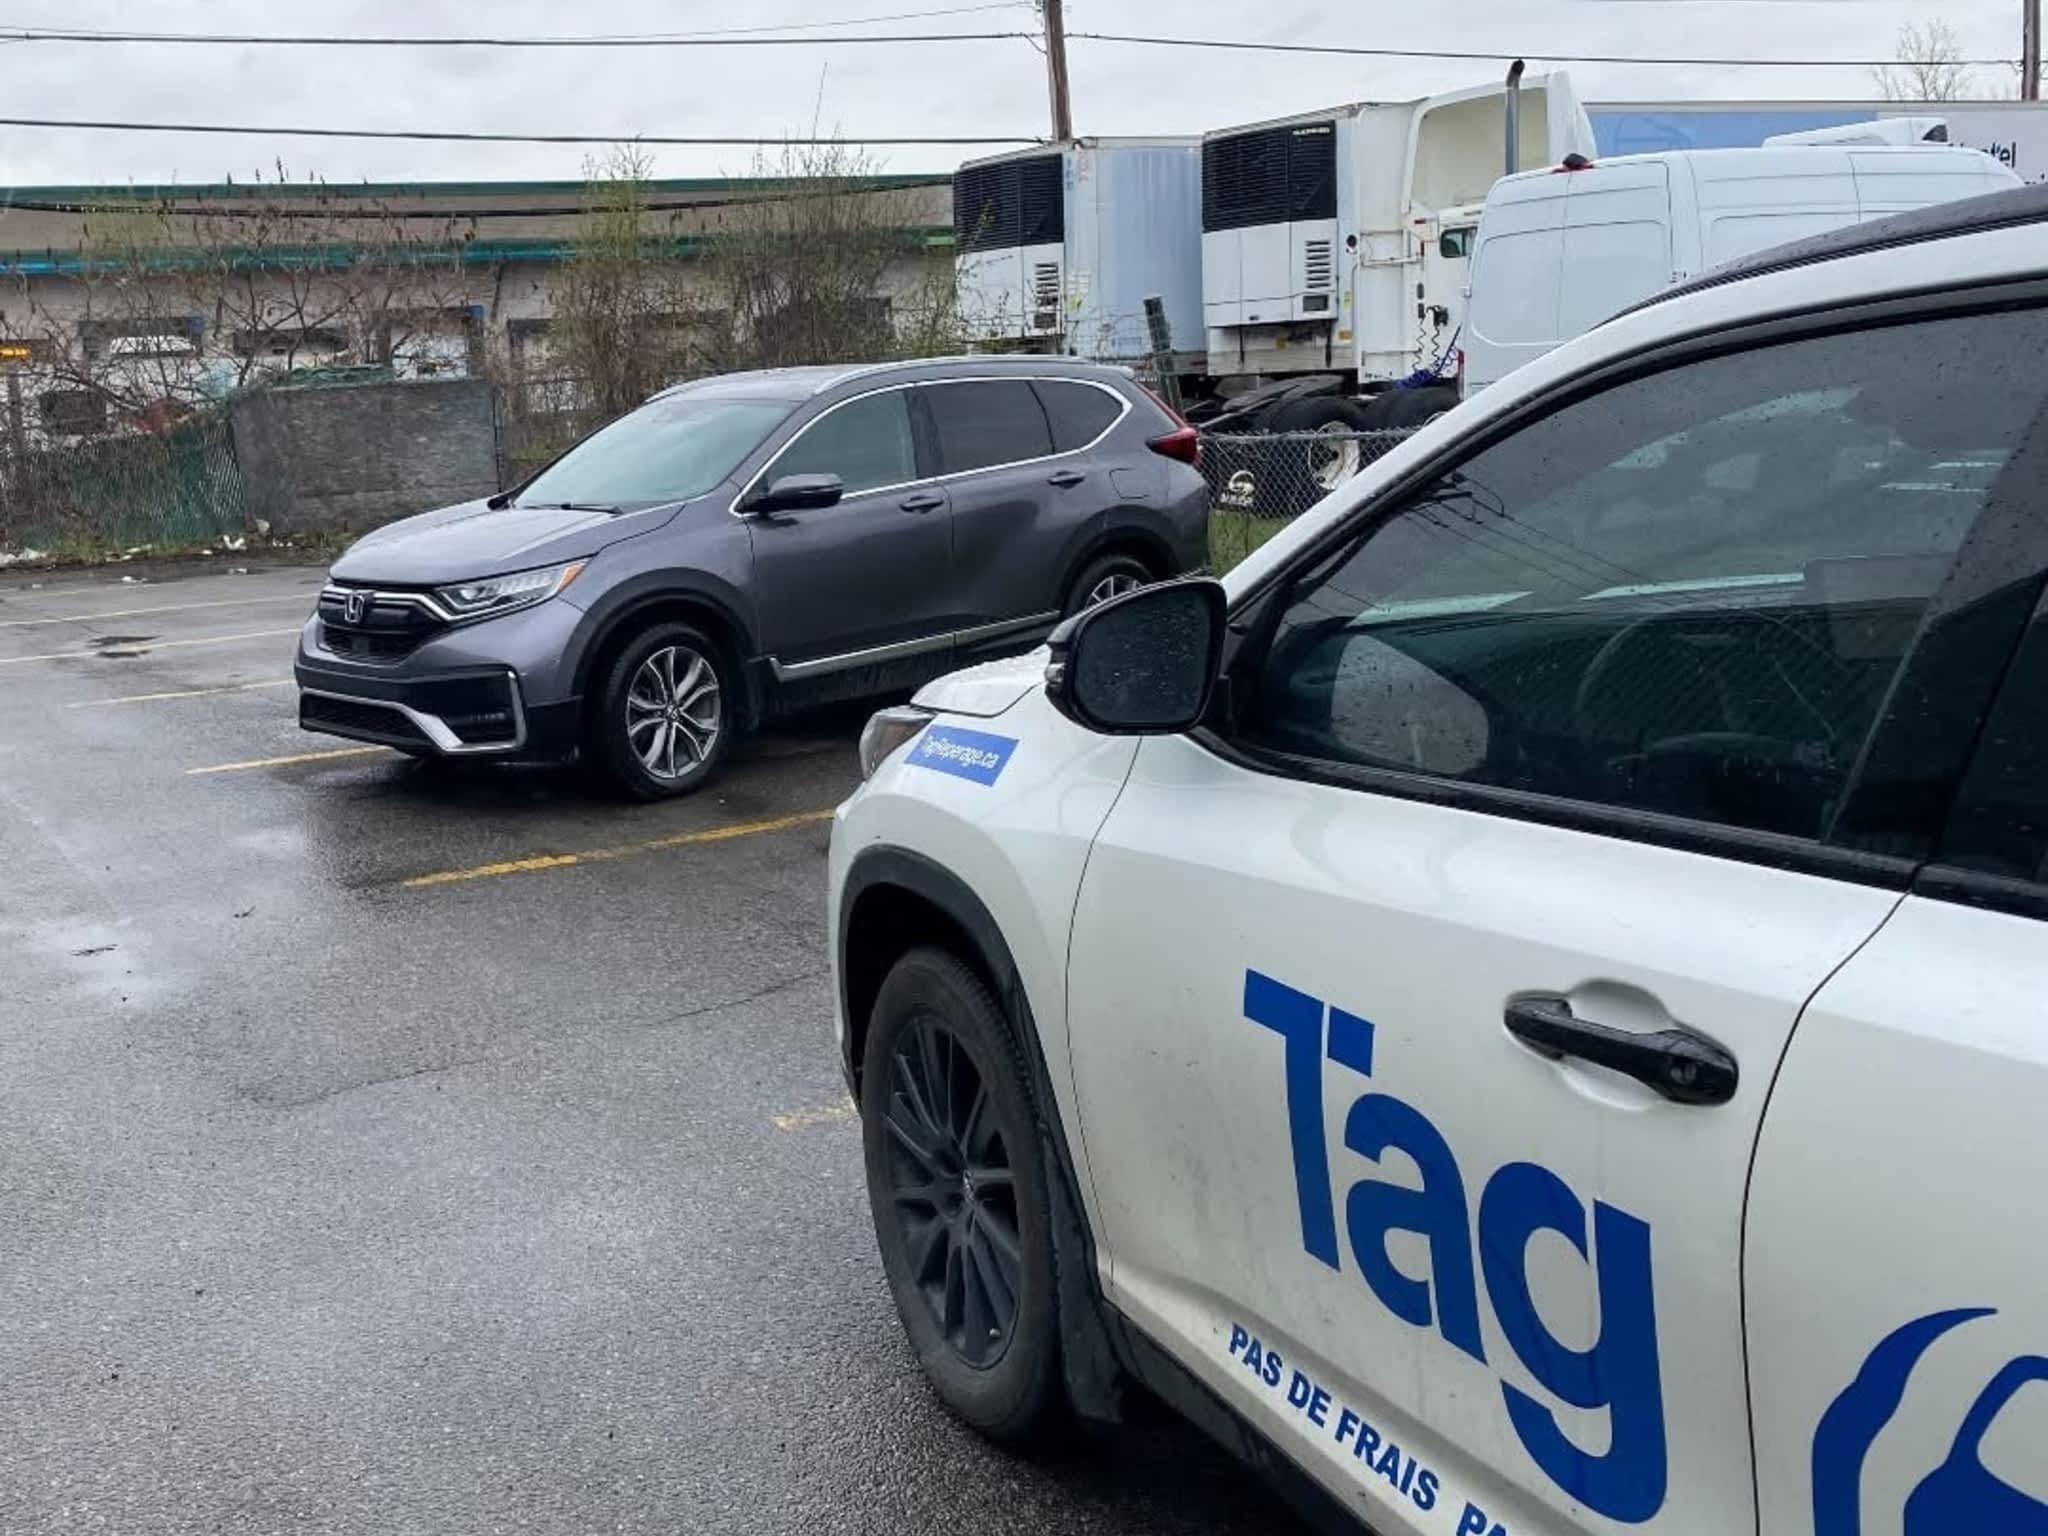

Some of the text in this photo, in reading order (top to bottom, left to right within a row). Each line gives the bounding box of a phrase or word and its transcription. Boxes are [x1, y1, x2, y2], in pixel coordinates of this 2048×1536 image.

[1229, 1323, 1507, 1536] PAS DE FRAIS P
[1242, 968, 1668, 1525] Tag
